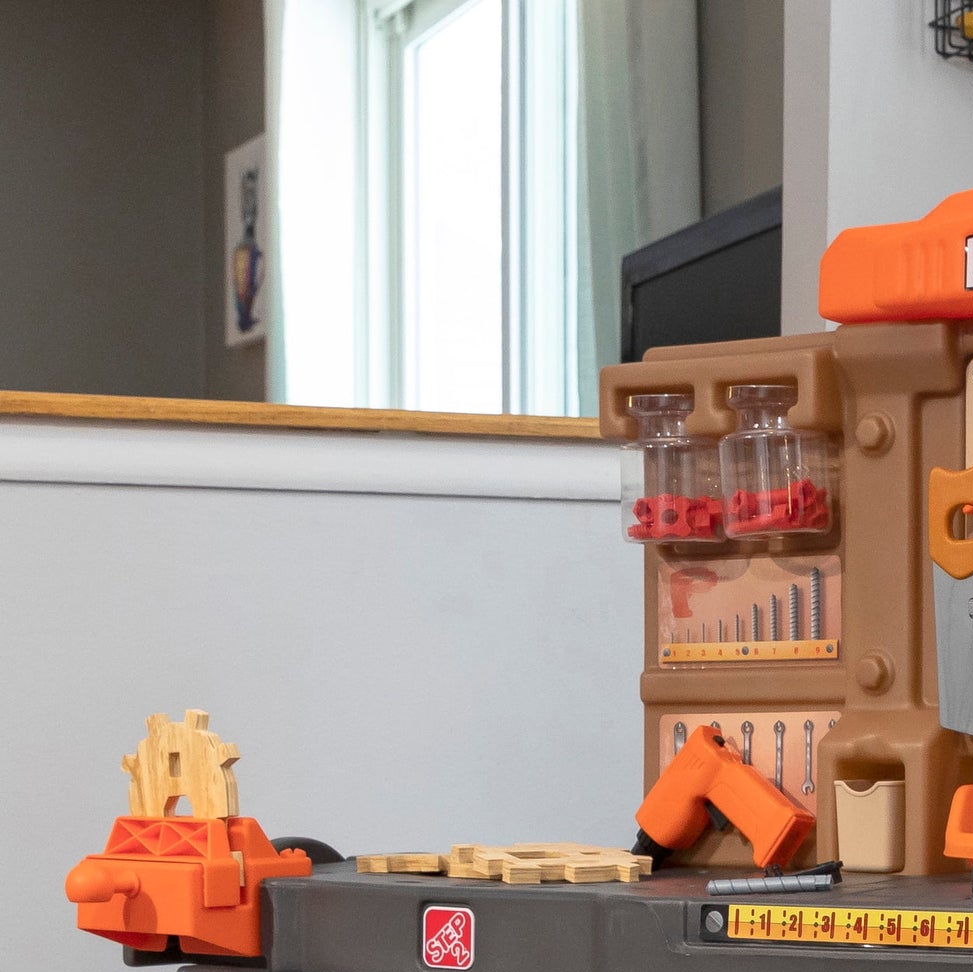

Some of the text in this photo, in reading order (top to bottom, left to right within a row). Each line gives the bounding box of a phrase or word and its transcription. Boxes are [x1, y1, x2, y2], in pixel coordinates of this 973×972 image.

[426, 912, 466, 963] STEP
[760, 914, 766, 930] 1
[789, 914, 797, 931] 2
[821, 915, 830, 932] 3
[853, 917, 863, 934] 4
[886, 918, 896, 935] 5
[920, 919, 930, 937] 6
[956, 920, 964, 938] 7
[451, 941, 470, 966] 2
